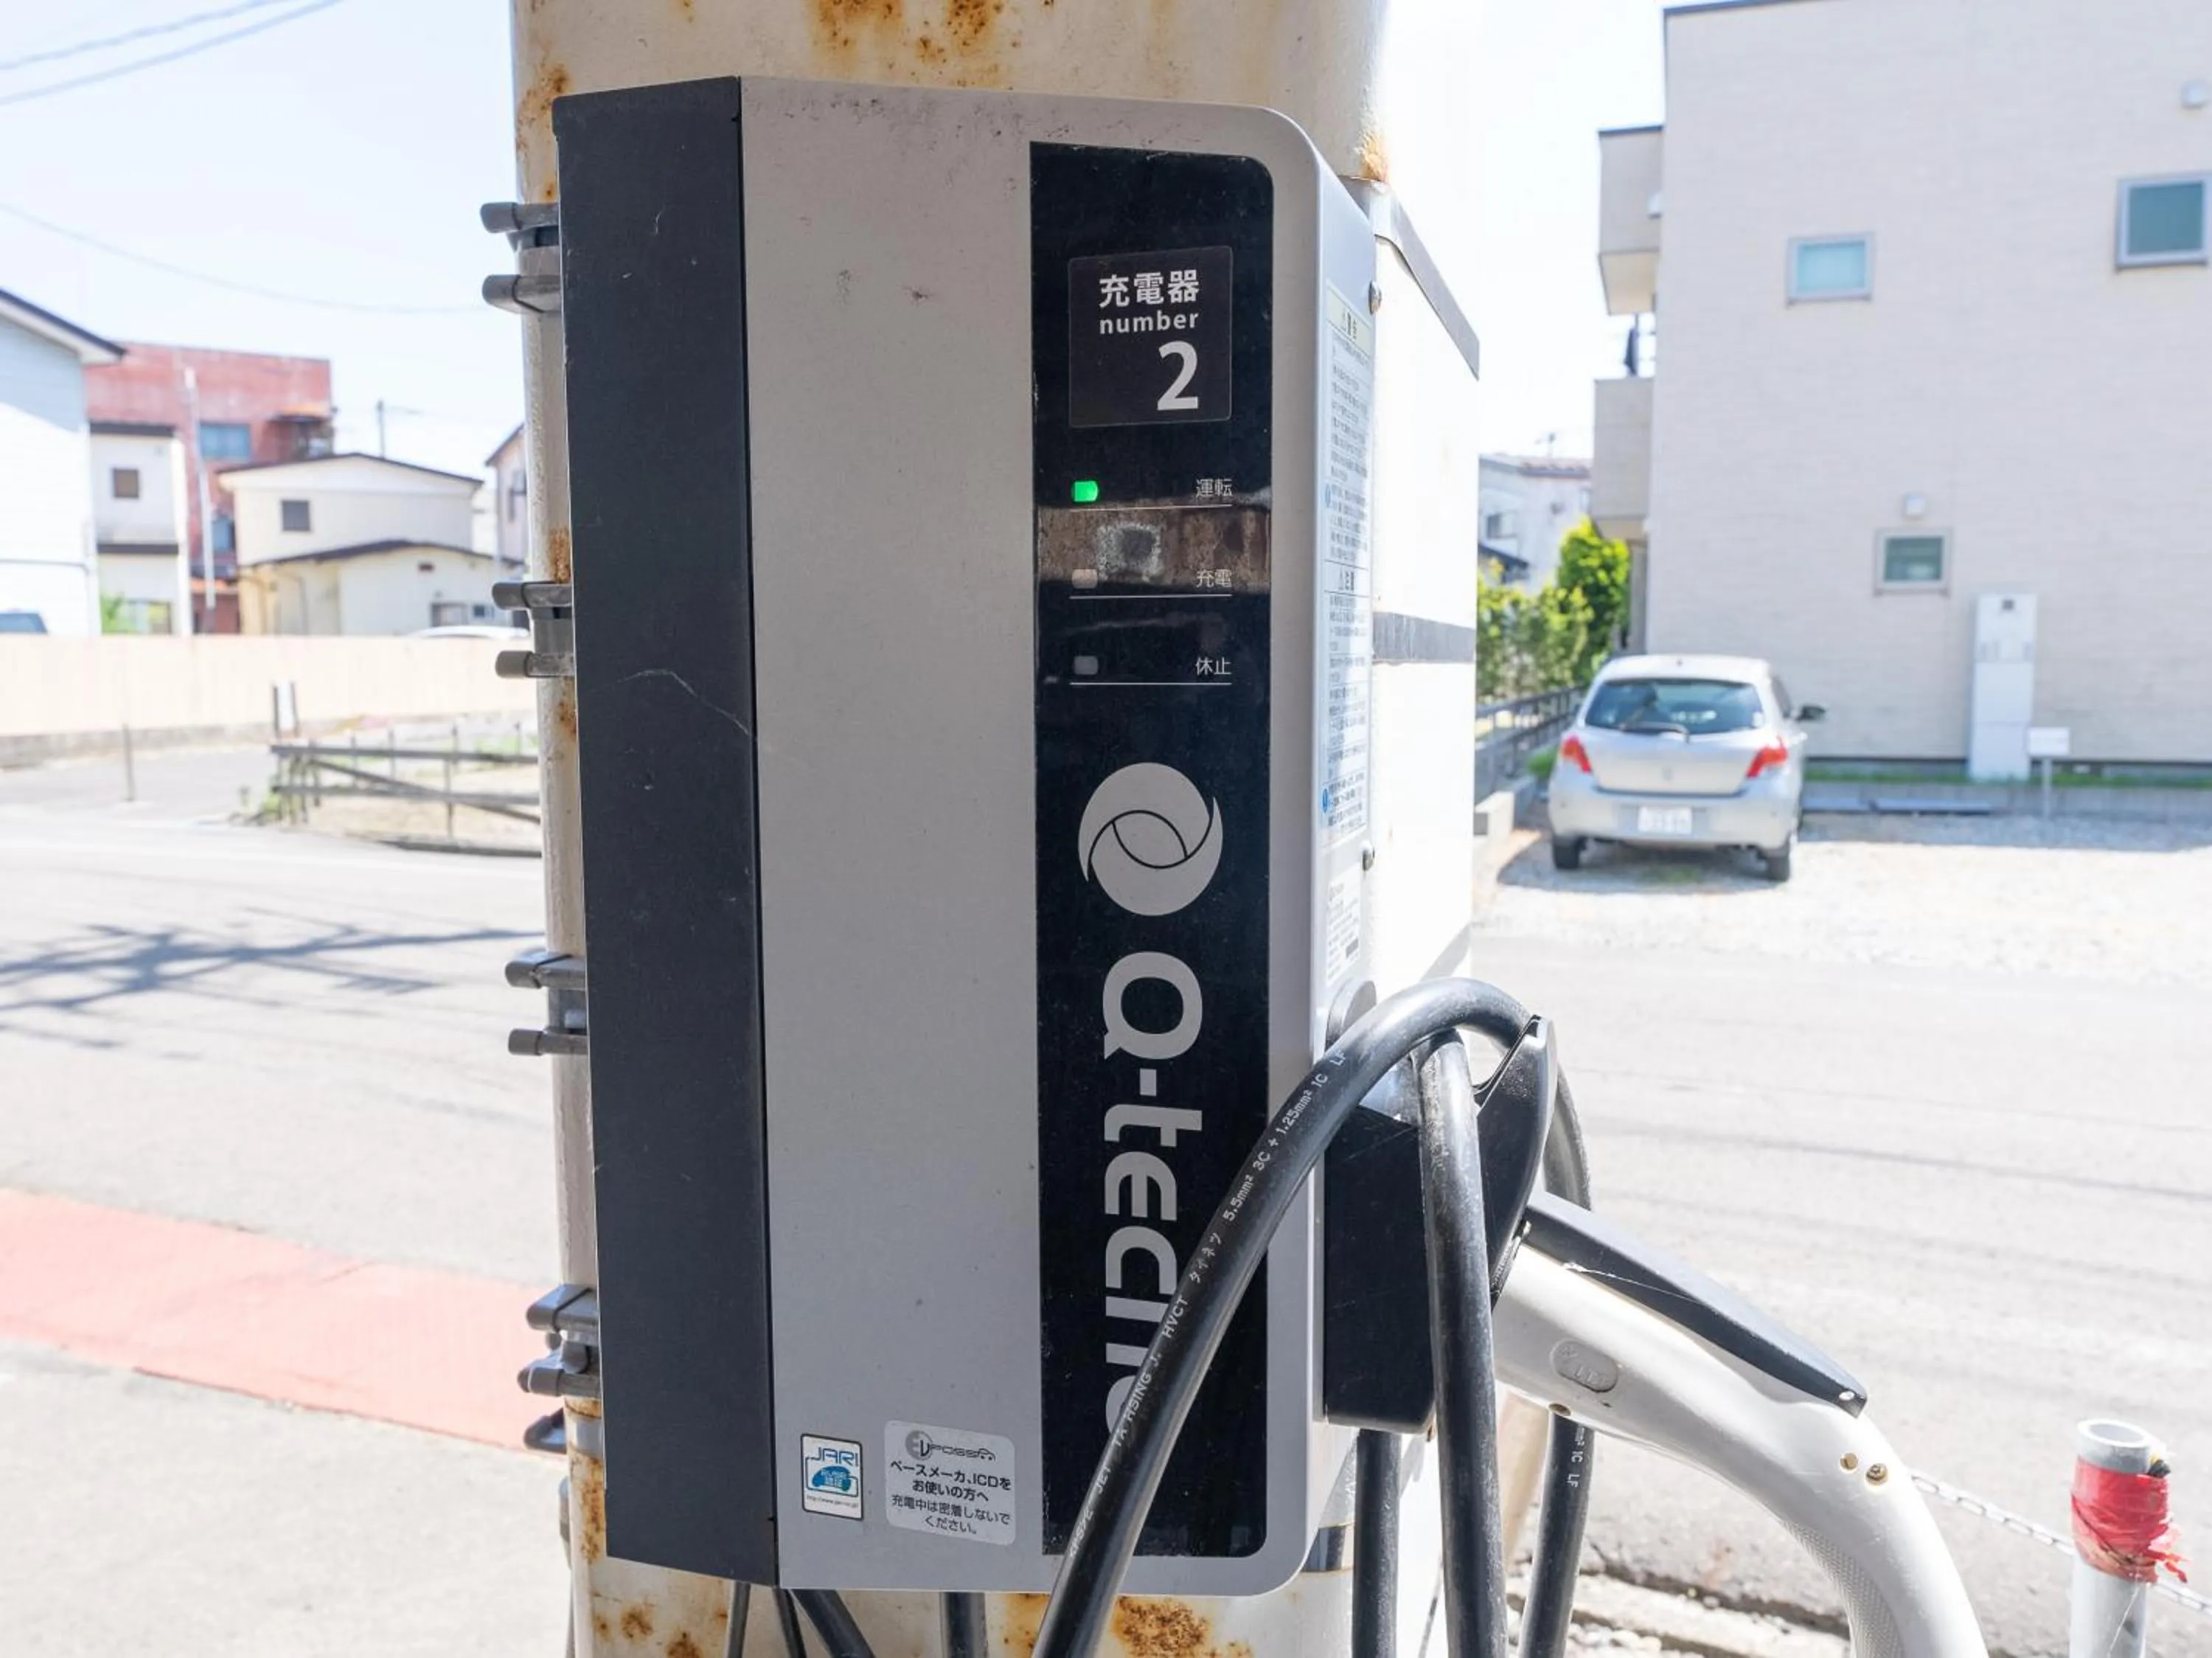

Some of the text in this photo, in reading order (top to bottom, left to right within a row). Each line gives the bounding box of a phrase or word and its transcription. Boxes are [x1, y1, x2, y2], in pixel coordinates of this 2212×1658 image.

[1099, 269, 1200, 308] 充電器
[1099, 310, 1200, 335] number
[1157, 341, 1200, 411] 2
[1195, 478, 1233, 498] 運転
[1195, 569, 1232, 589] 充電
[1194, 657, 1232, 676] 休止
[1162, 1294, 1189, 1339] HVCT
[1253, 1151, 1270, 1171] 3C
[815, 1446, 859, 1467] JARI
[912, 1480, 989, 1502] お使いの方へ
[891, 1494, 1011, 1525] 充電中は密着しないで
